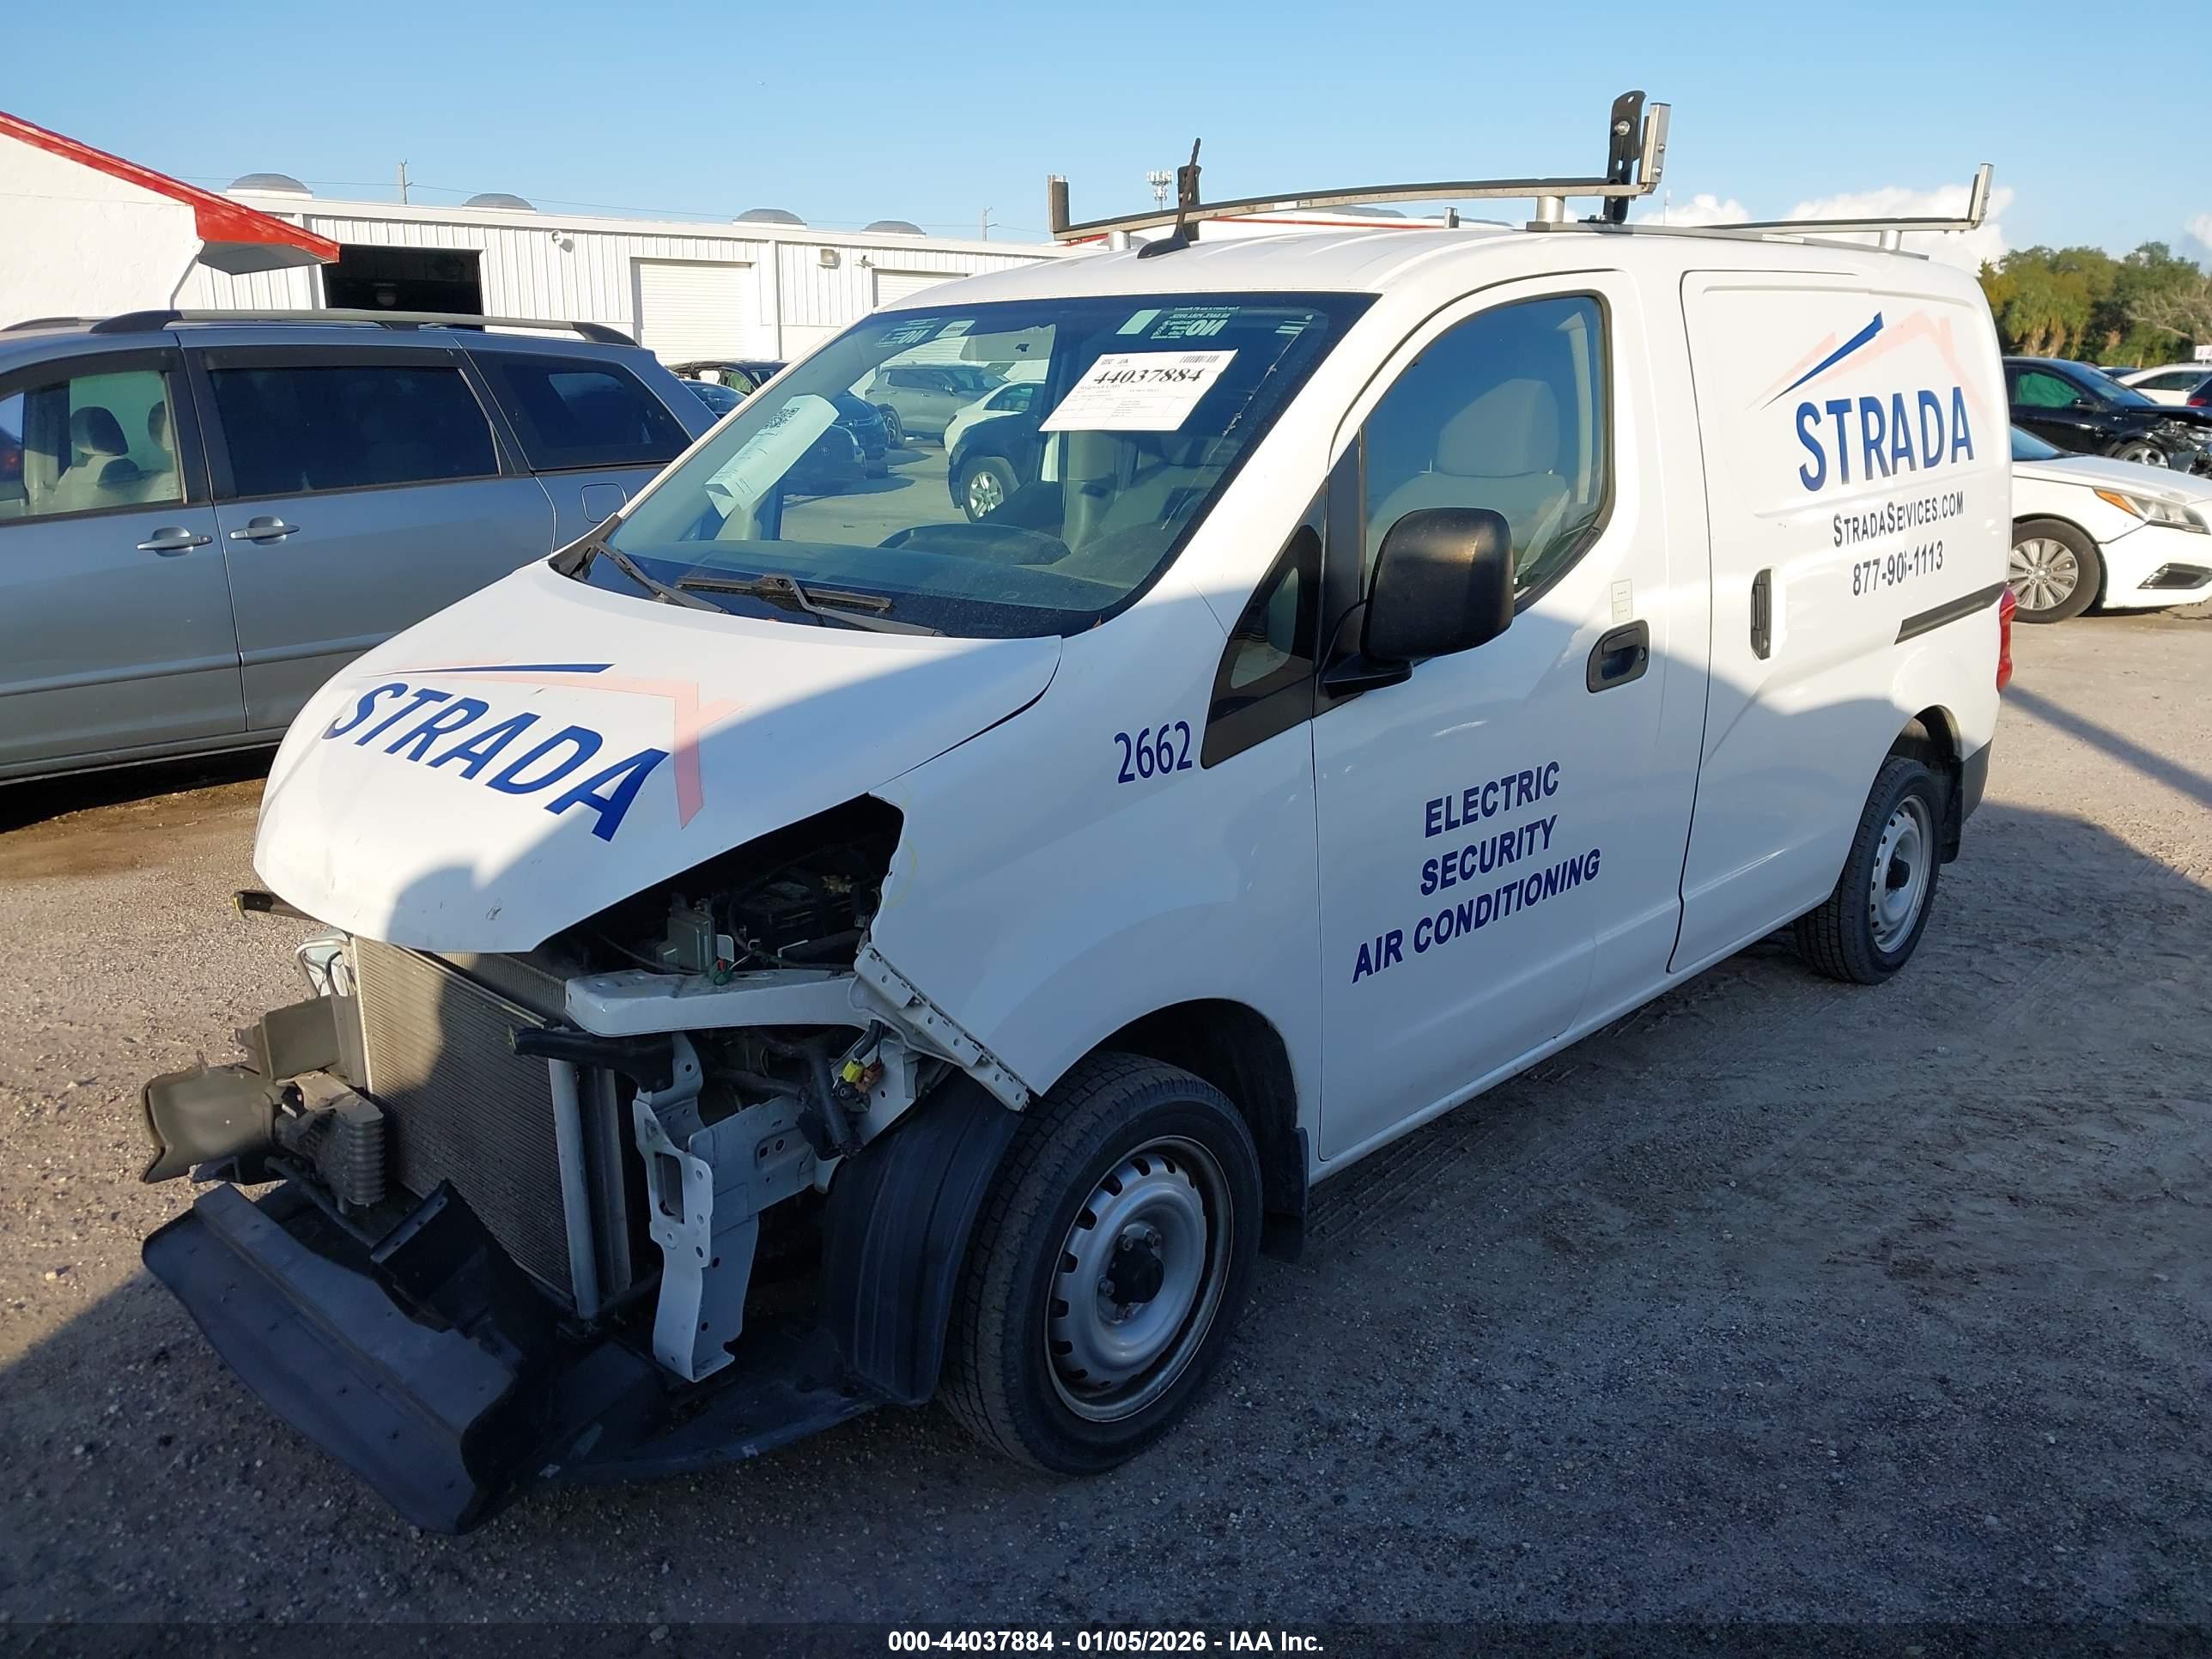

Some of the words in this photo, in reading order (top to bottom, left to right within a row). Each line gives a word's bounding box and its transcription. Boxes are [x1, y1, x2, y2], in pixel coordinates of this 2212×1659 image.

[1094, 368, 1206, 385] 44037884
[1796, 386, 1975, 492] STRADA
[322, 682, 670, 842] STRADA
[1114, 720, 1193, 784] 2662
[1424, 760, 1560, 838] ELECTRIC
[1419, 814, 1559, 896] SECURITY
[1352, 927, 1404, 984] AIR
[1413, 848, 1601, 954] CONDITIONING
